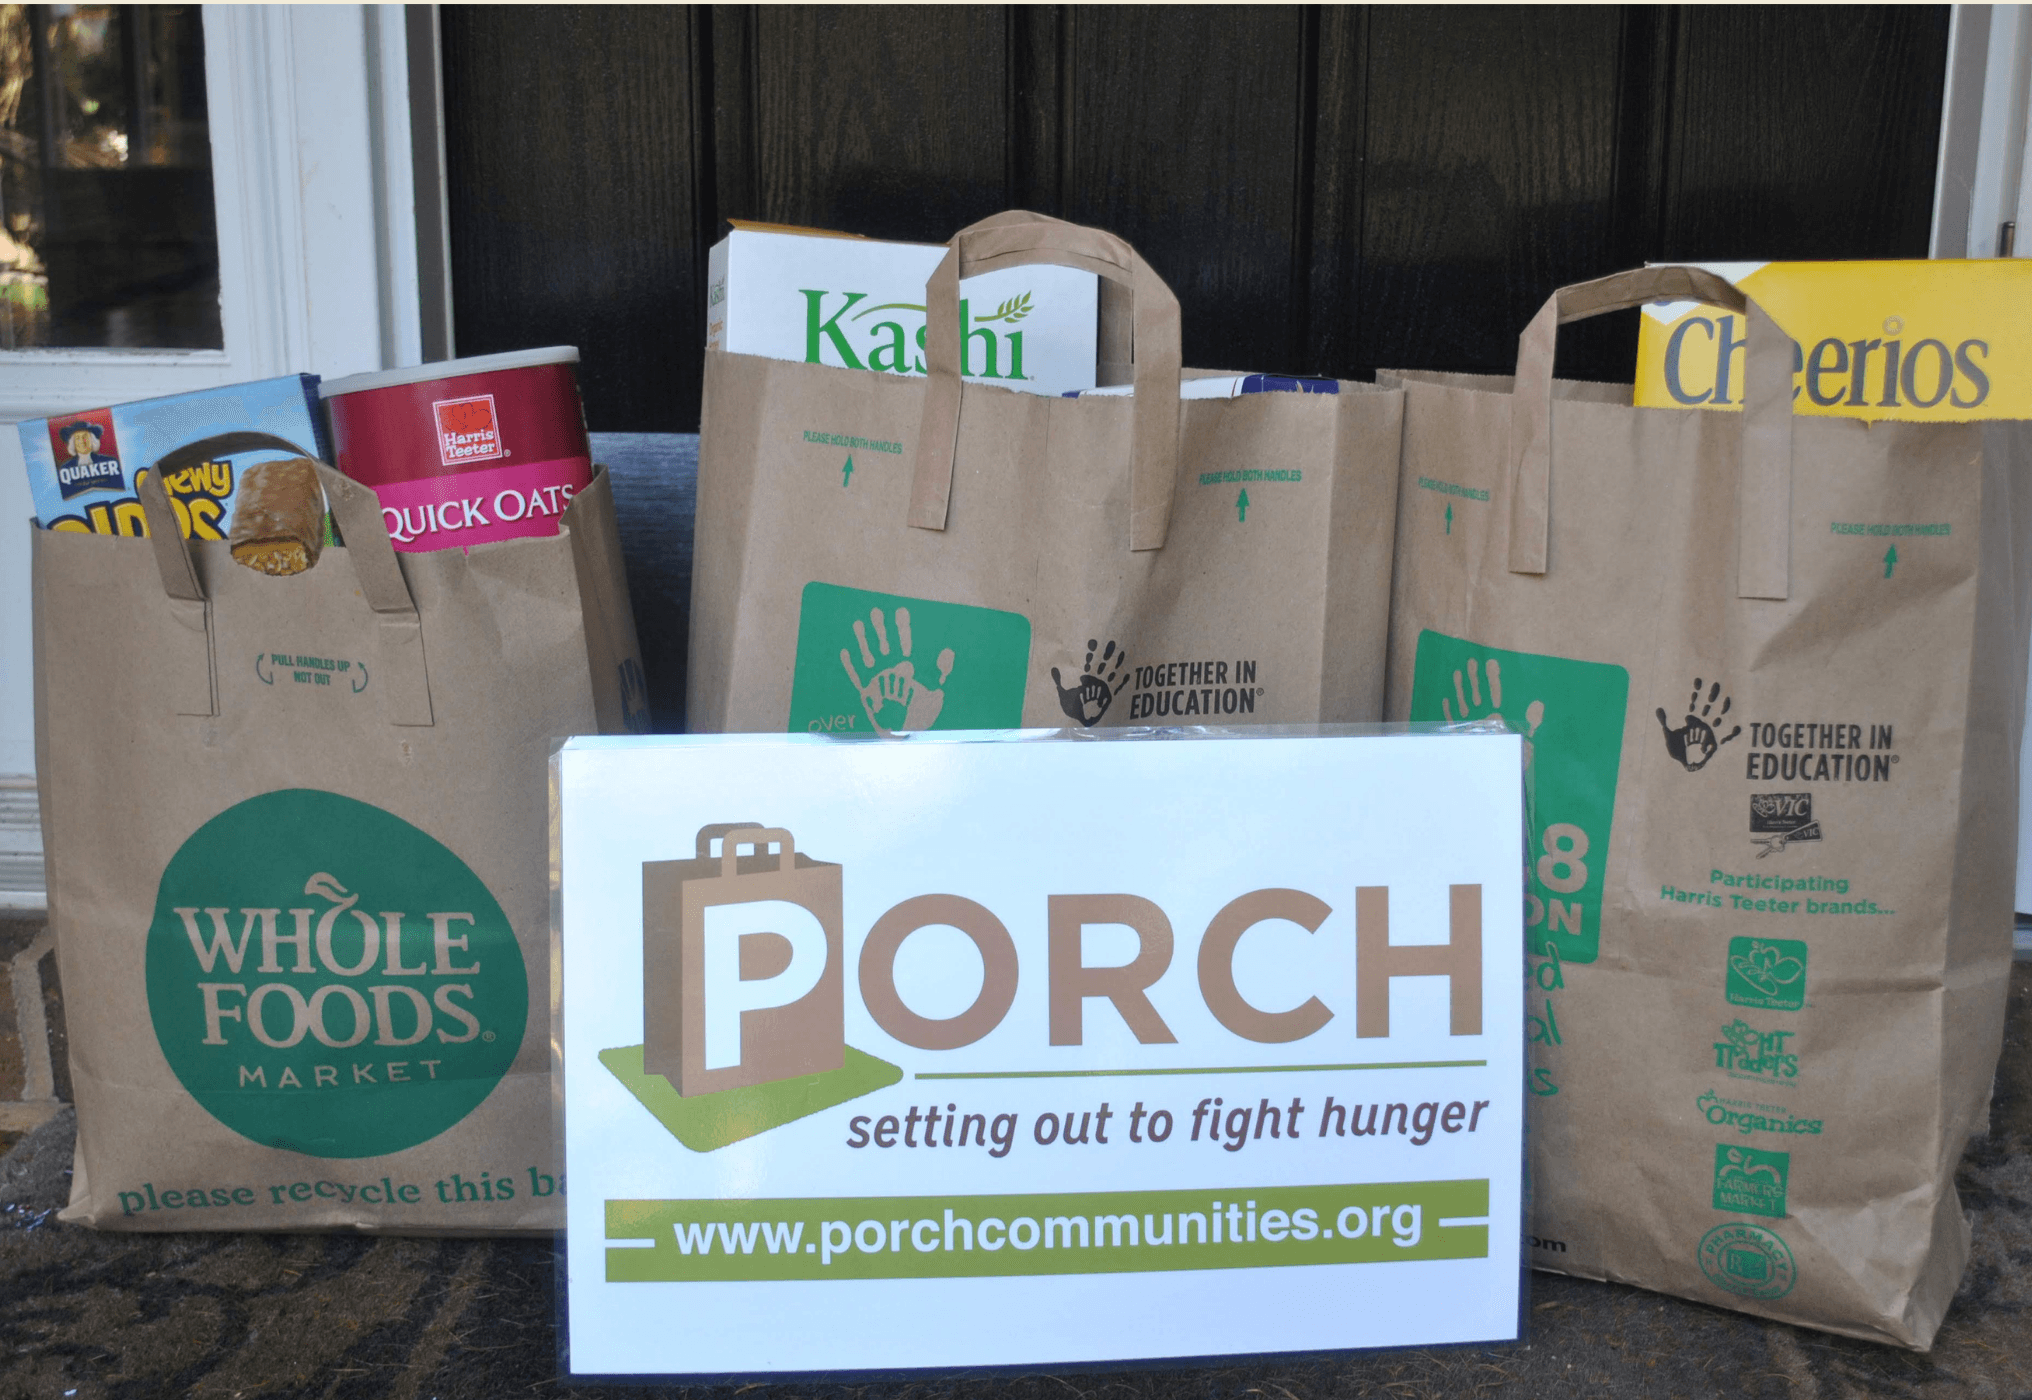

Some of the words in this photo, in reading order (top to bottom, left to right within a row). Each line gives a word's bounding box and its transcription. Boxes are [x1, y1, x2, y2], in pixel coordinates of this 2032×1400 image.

[444, 429, 494, 446] Harris
[446, 441, 495, 458] Teeter
[803, 430, 830, 445] PLEASE
[831, 434, 848, 448] HOLD
[849, 436, 869, 450] BOTH
[870, 440, 903, 455] HANDLES
[59, 460, 120, 485] QUAKER
[1224, 469, 1241, 483] HOLD
[1243, 469, 1263, 482] BOTH
[1264, 468, 1302, 483] HANDLES
[381, 497, 490, 542] QUICK
[271, 653, 294, 667] PULL
[296, 655, 335, 671] HANDLES
[337, 660, 350, 672] UP
[1135, 661, 1228, 690] TOGETHER
[1235, 660, 1257, 684] IN
[293, 671, 312, 683] NOT
[314, 673, 331, 685] OUT
[1129, 687, 1255, 720] EDUCATION
[808, 714, 856, 732] over
[1750, 722, 1861, 749] TOGETHER
[1869, 724, 1892, 750] IN
[1746, 752, 1890, 782] EDUCATION
[1775, 799, 1809, 816] VIC
[1537, 822, 1589, 893] 8
[1710, 869, 1849, 894] Participating
[1660, 885, 1723, 908] Harris
[1730, 894, 1801, 914] Teeter
[173, 897, 480, 976] WHOLE
[704, 883, 1483, 1071] PORCH
[197, 983, 480, 1048] FOODS
[239, 1060, 441, 1088] MARKET
[846, 1103, 1017, 1158] setting
[1034, 1103, 1109, 1146] out
[1129, 1102, 1173, 1144] to
[1190, 1096, 1304, 1153] fight
[1318, 1096, 1490, 1147] hunger
[1706, 1105, 1823, 1135] Organics
[118, 1183, 256, 1217] please
[269, 1177, 421, 1206] recycle
[435, 1171, 515, 1204] this
[673, 1200, 1422, 1265] www.porchcommunities.org
